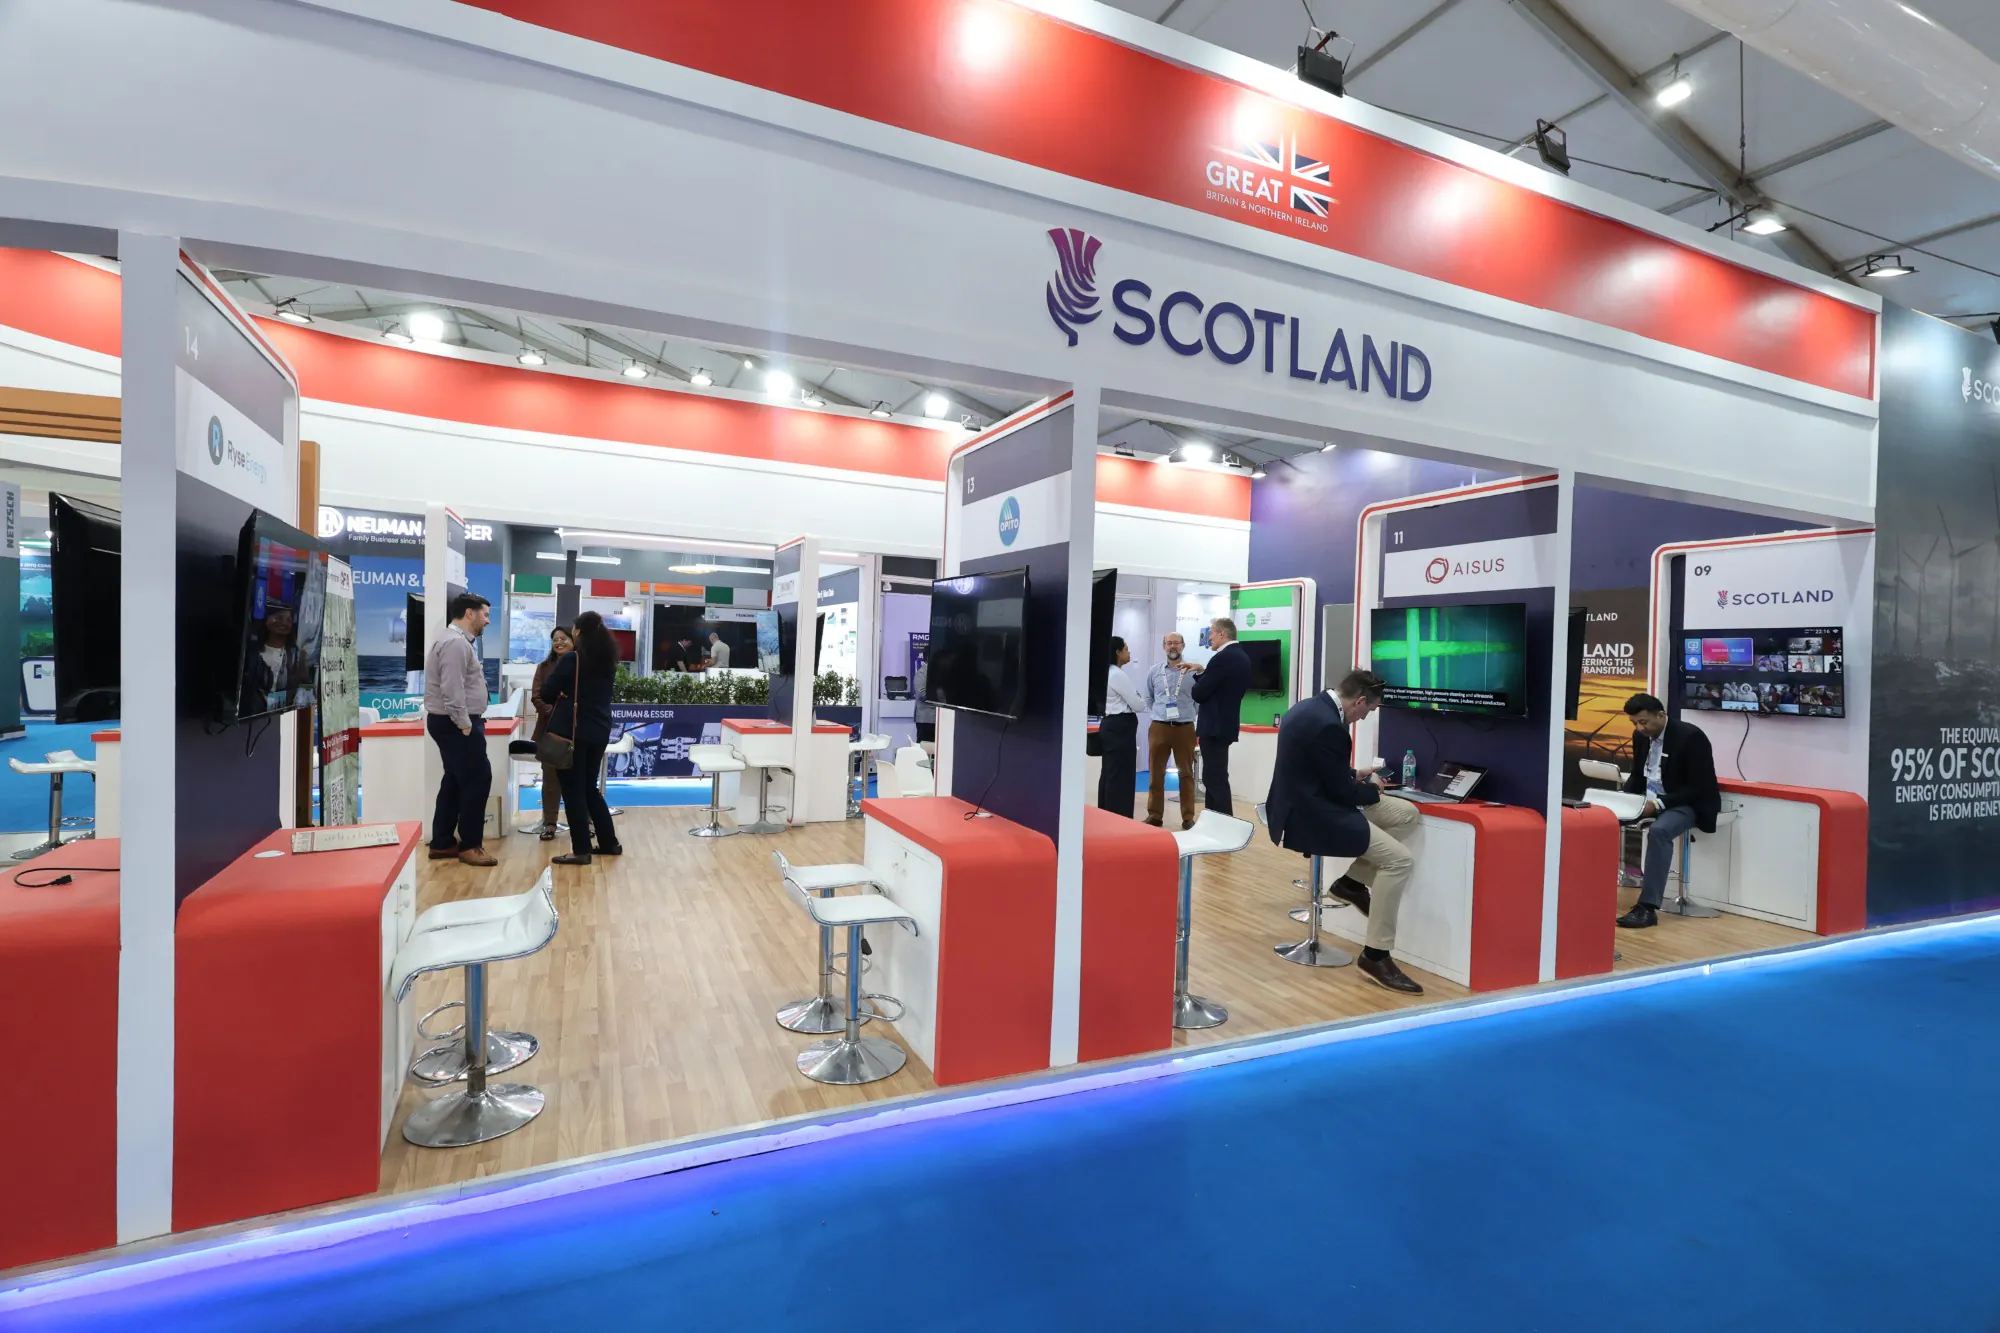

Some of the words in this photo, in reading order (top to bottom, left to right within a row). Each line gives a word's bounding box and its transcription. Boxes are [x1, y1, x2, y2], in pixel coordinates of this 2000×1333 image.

[1206, 160, 1283, 204] GREAT
[1206, 189, 1239, 207] BRITAIN
[1241, 200, 1247, 209] &
[1248, 202, 1293, 223] NORTHERN
[1295, 216, 1328, 233] IRELAND
[185, 325, 199, 361] 14
[1112, 279, 1432, 402] SCOTLAND
[967, 476, 975, 495] 13
[6, 491, 15, 549] NETZSCH
[346, 515, 422, 537] NEUMAN
[1000, 518, 1019, 532] OPITO
[348, 533, 370, 544] Family
[370, 534, 399, 544] Business
[399, 536, 417, 545] since
[1393, 530, 1404, 545] 11
[1453, 558, 1505, 576] AISUS
[1694, 565, 1712, 577] 09
[408, 573, 420, 587] &
[1732, 589, 1834, 606] SCOTLAND
[1583, 643, 1634, 658] LAND
[1615, 658, 1634, 667] THE
[611, 709, 643, 719] NEUMAN
[644, 710, 650, 719] &
[650, 710, 674, 719] ESSER
[1940, 727, 1960, 744] THE
[1890, 747, 1934, 782] 95%
[1939, 747, 1968, 780] OF
[1895, 784, 1939, 803] ENERGY
[1929, 804, 1939, 821] IS
[1941, 802, 1972, 820] FROM
[1973, 800, 2000, 818] RENE
